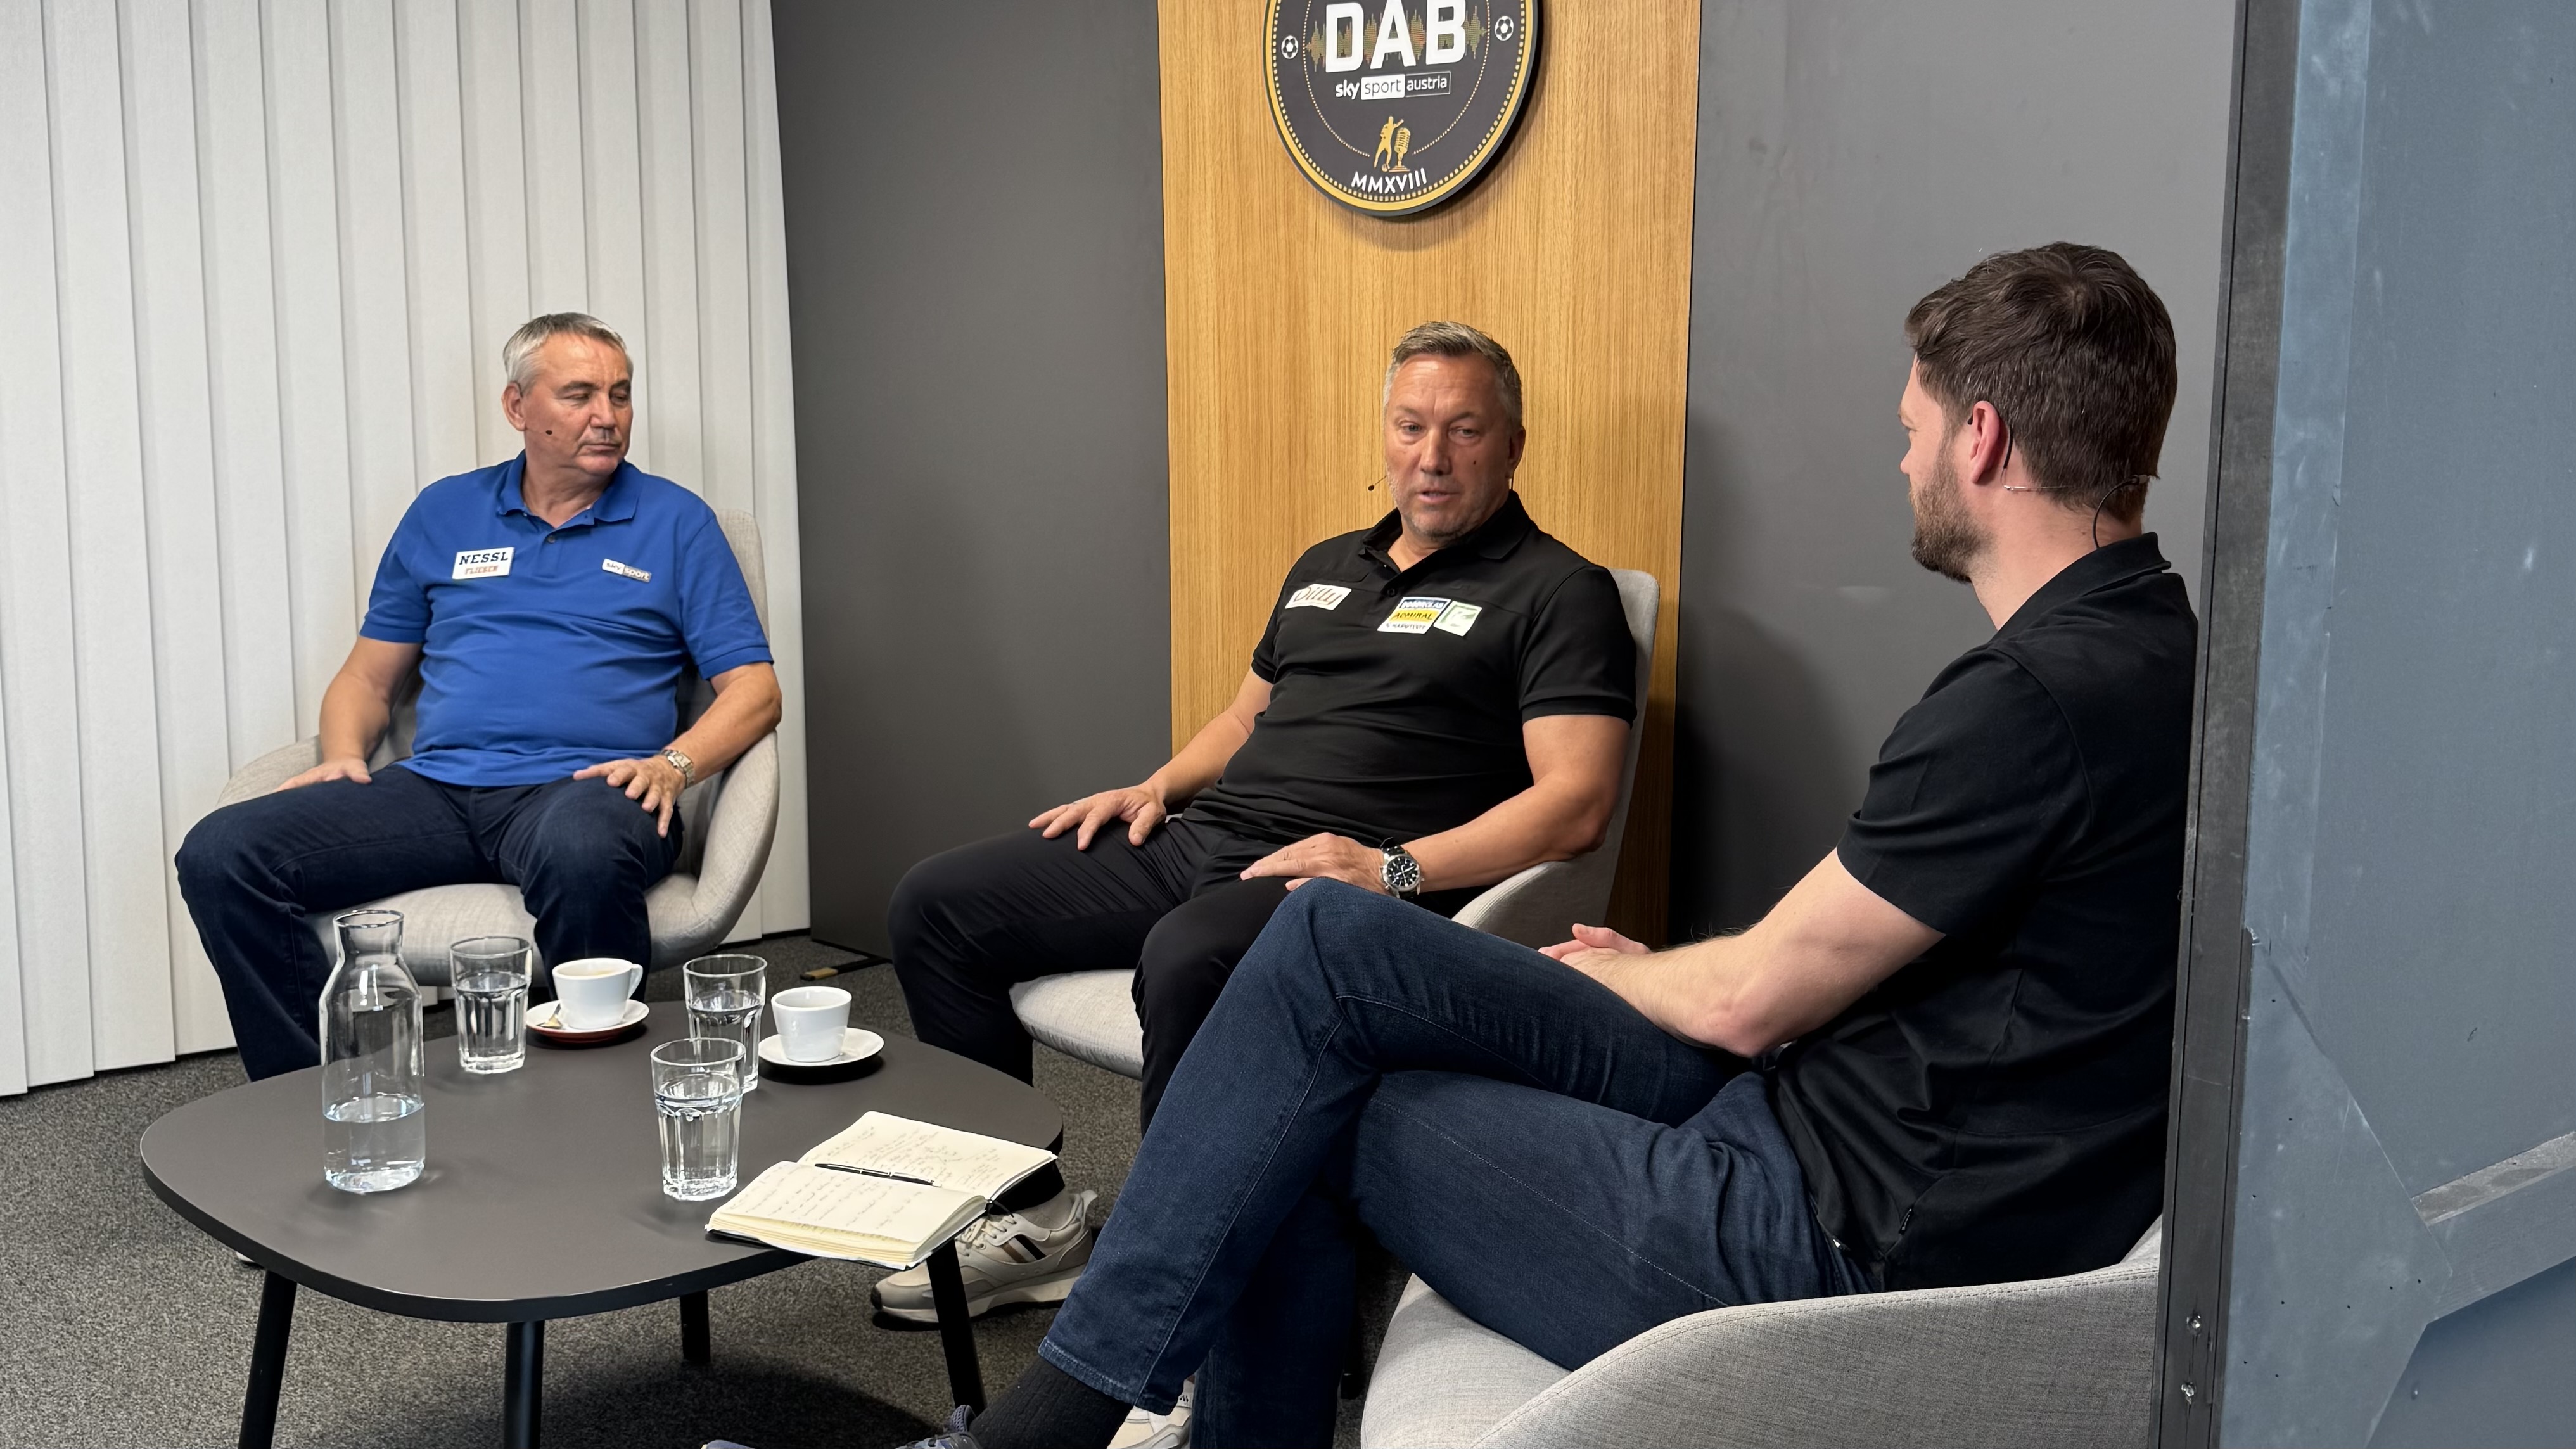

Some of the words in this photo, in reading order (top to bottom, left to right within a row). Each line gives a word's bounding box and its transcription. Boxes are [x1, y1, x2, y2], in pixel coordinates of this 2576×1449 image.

[1325, 0, 1466, 73] DAB
[1335, 79, 1360, 100] sky
[1364, 79, 1402, 98] sport
[1406, 75, 1448, 91] austria
[1350, 167, 1427, 194] MMXVIII
[459, 551, 509, 565] NESSL
[1391, 612, 1433, 622] ADMIRAL
